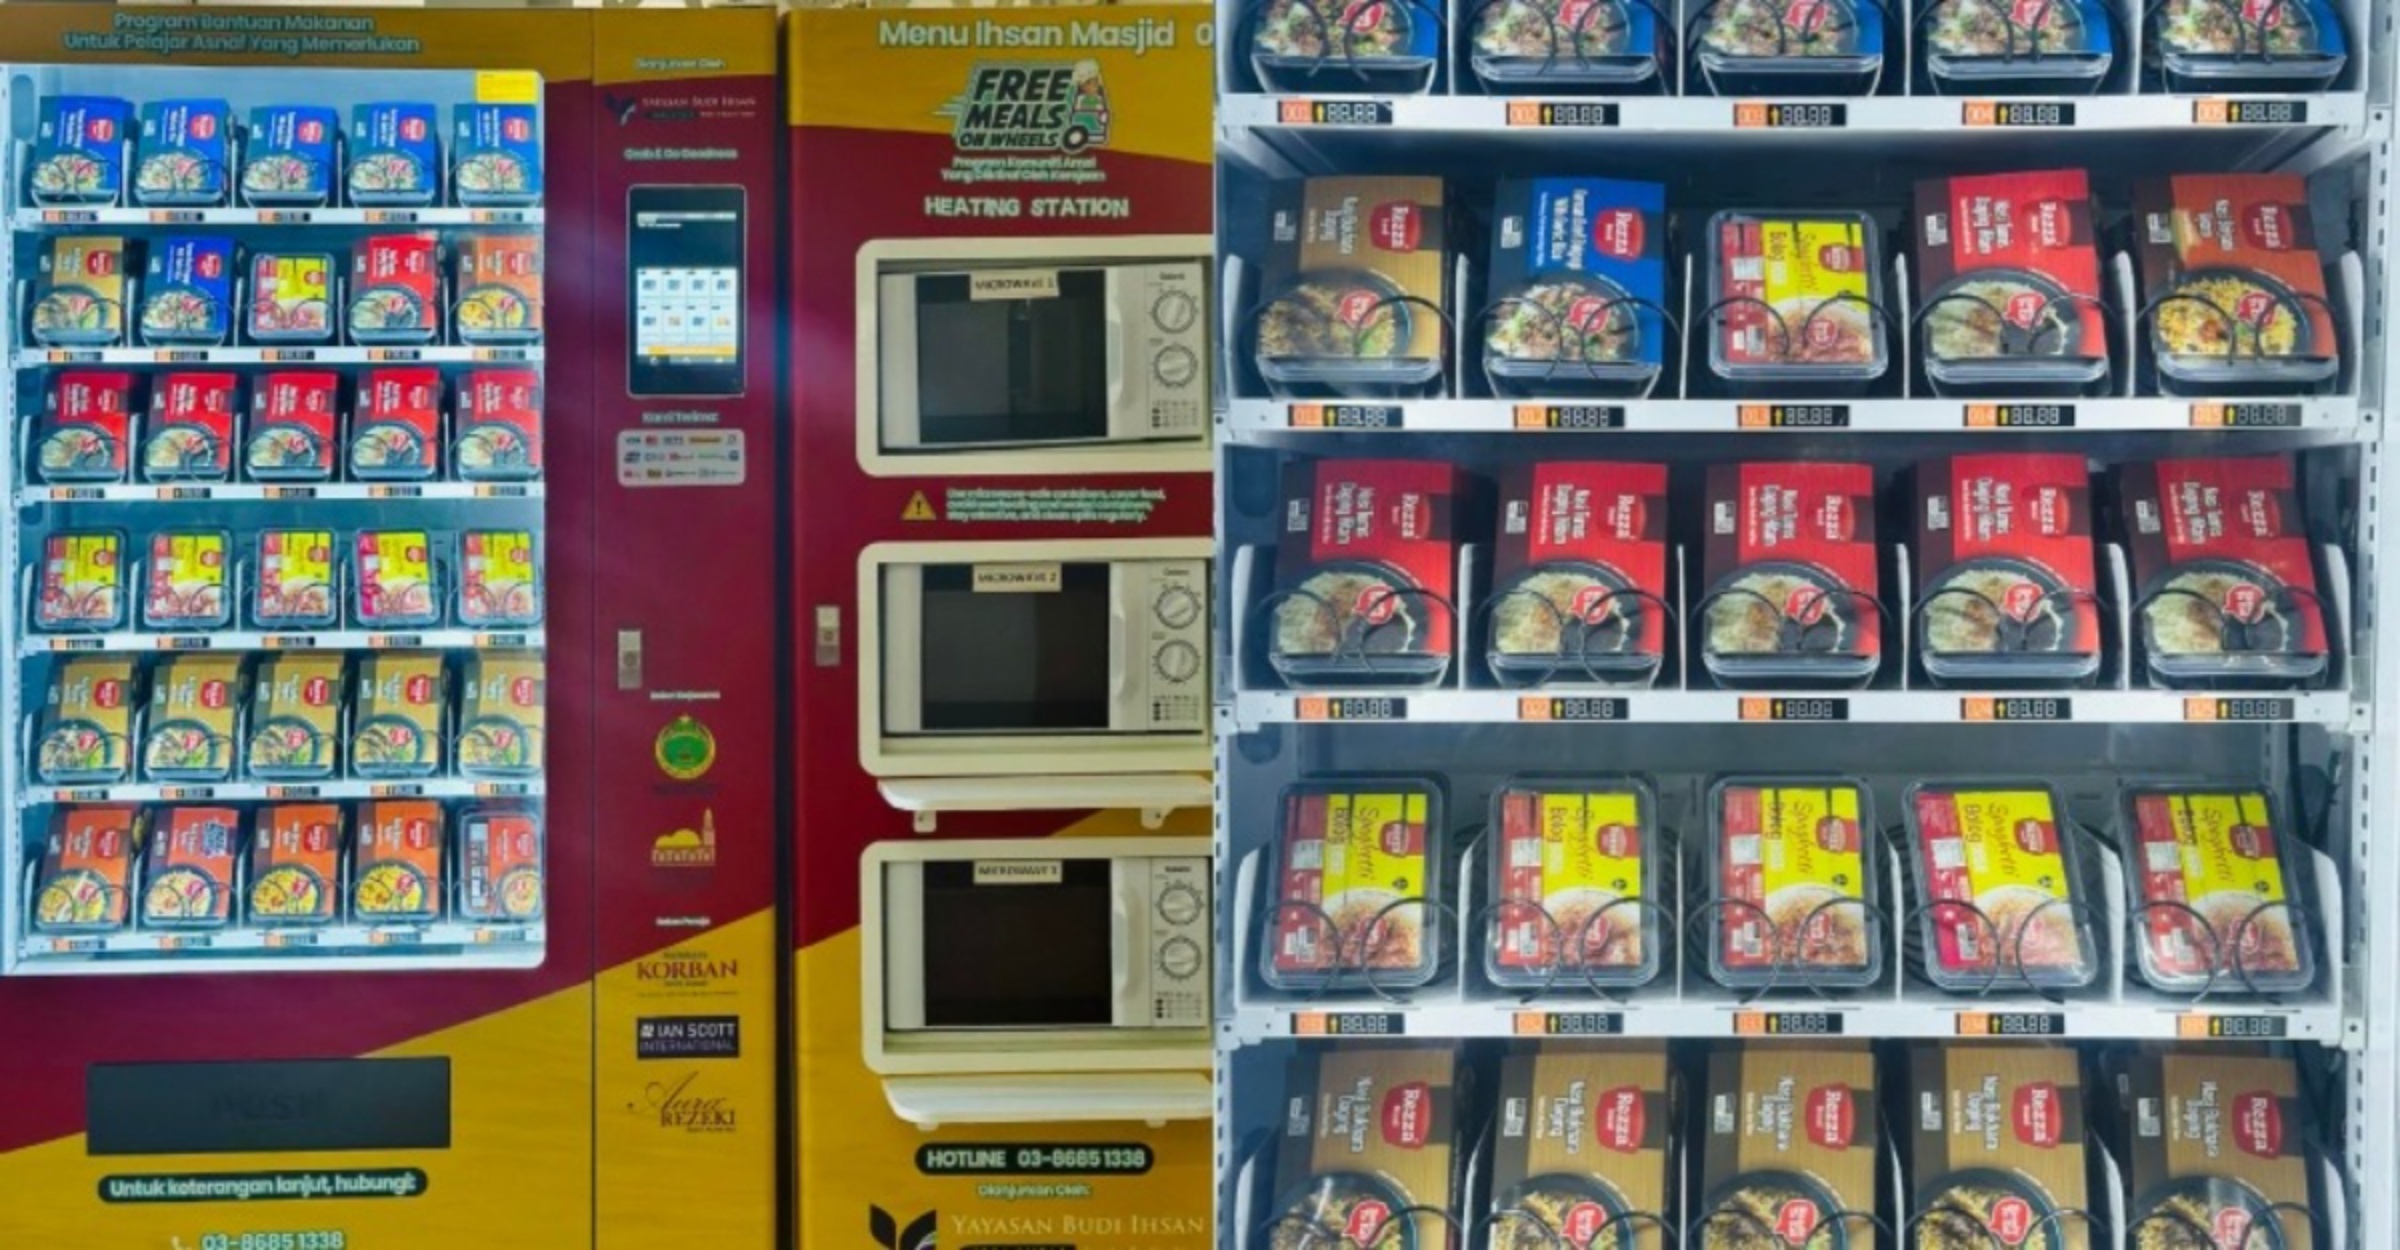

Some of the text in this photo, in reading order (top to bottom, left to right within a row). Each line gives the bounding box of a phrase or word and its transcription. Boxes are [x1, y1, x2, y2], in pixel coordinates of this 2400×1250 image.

[114, 13, 375, 33] Program Bantuan Makanan
[879, 20, 968, 46] Menu
[976, 20, 1063, 46] Ihsan
[1070, 18, 1175, 55] Masjid
[64, 33, 121, 49] Untuk
[124, 33, 190, 54] Pelajar
[249, 36, 300, 55] Yang
[302, 36, 419, 51] Memerlukan
[973, 68, 1075, 102] FREE
[965, 103, 1066, 129] MEALS
[959, 132, 1058, 147] ON WHEELS
[925, 196, 1129, 216] HEATING STATION
[1402, 494, 1419, 538] Rezza
[1617, 495, 1635, 538] Rezza
[1825, 495, 1843, 539] Rezza
[2039, 487, 2056, 535] Rezza
[2248, 491, 2267, 536] Rezza
[1358, 808, 1380, 880] Spaghetti
[1575, 807, 1595, 880] Spaghetti
[1794, 800, 1815, 874] Spaghetti
[1988, 802, 2020, 878] Spaghetti
[2202, 807, 2234, 882] Spaghetti
[636, 959, 738, 980] KORBAN
[640, 1038, 736, 1052] INTERNATIONAL
[657, 1023, 735, 1037] IAN SCOTT
[660, 1109, 736, 1128] REZEKI
[1401, 1089, 1421, 1142] Rezza
[1615, 1092, 1634, 1146] Rezza
[1825, 1090, 1843, 1143] Rezza
[2031, 1088, 2049, 1141] Rezza
[2251, 1097, 2268, 1150] Rezza
[927, 1148, 1145, 1168] HOTLINE 03-8685 1338
[110, 1179, 166, 1198] Untuk
[168, 1177, 273, 1198] keterangan
[203, 1231, 344, 1250] 03-8685 1338
[951, 1214, 1204, 1235] YAYASAN BUDI IHSAN
